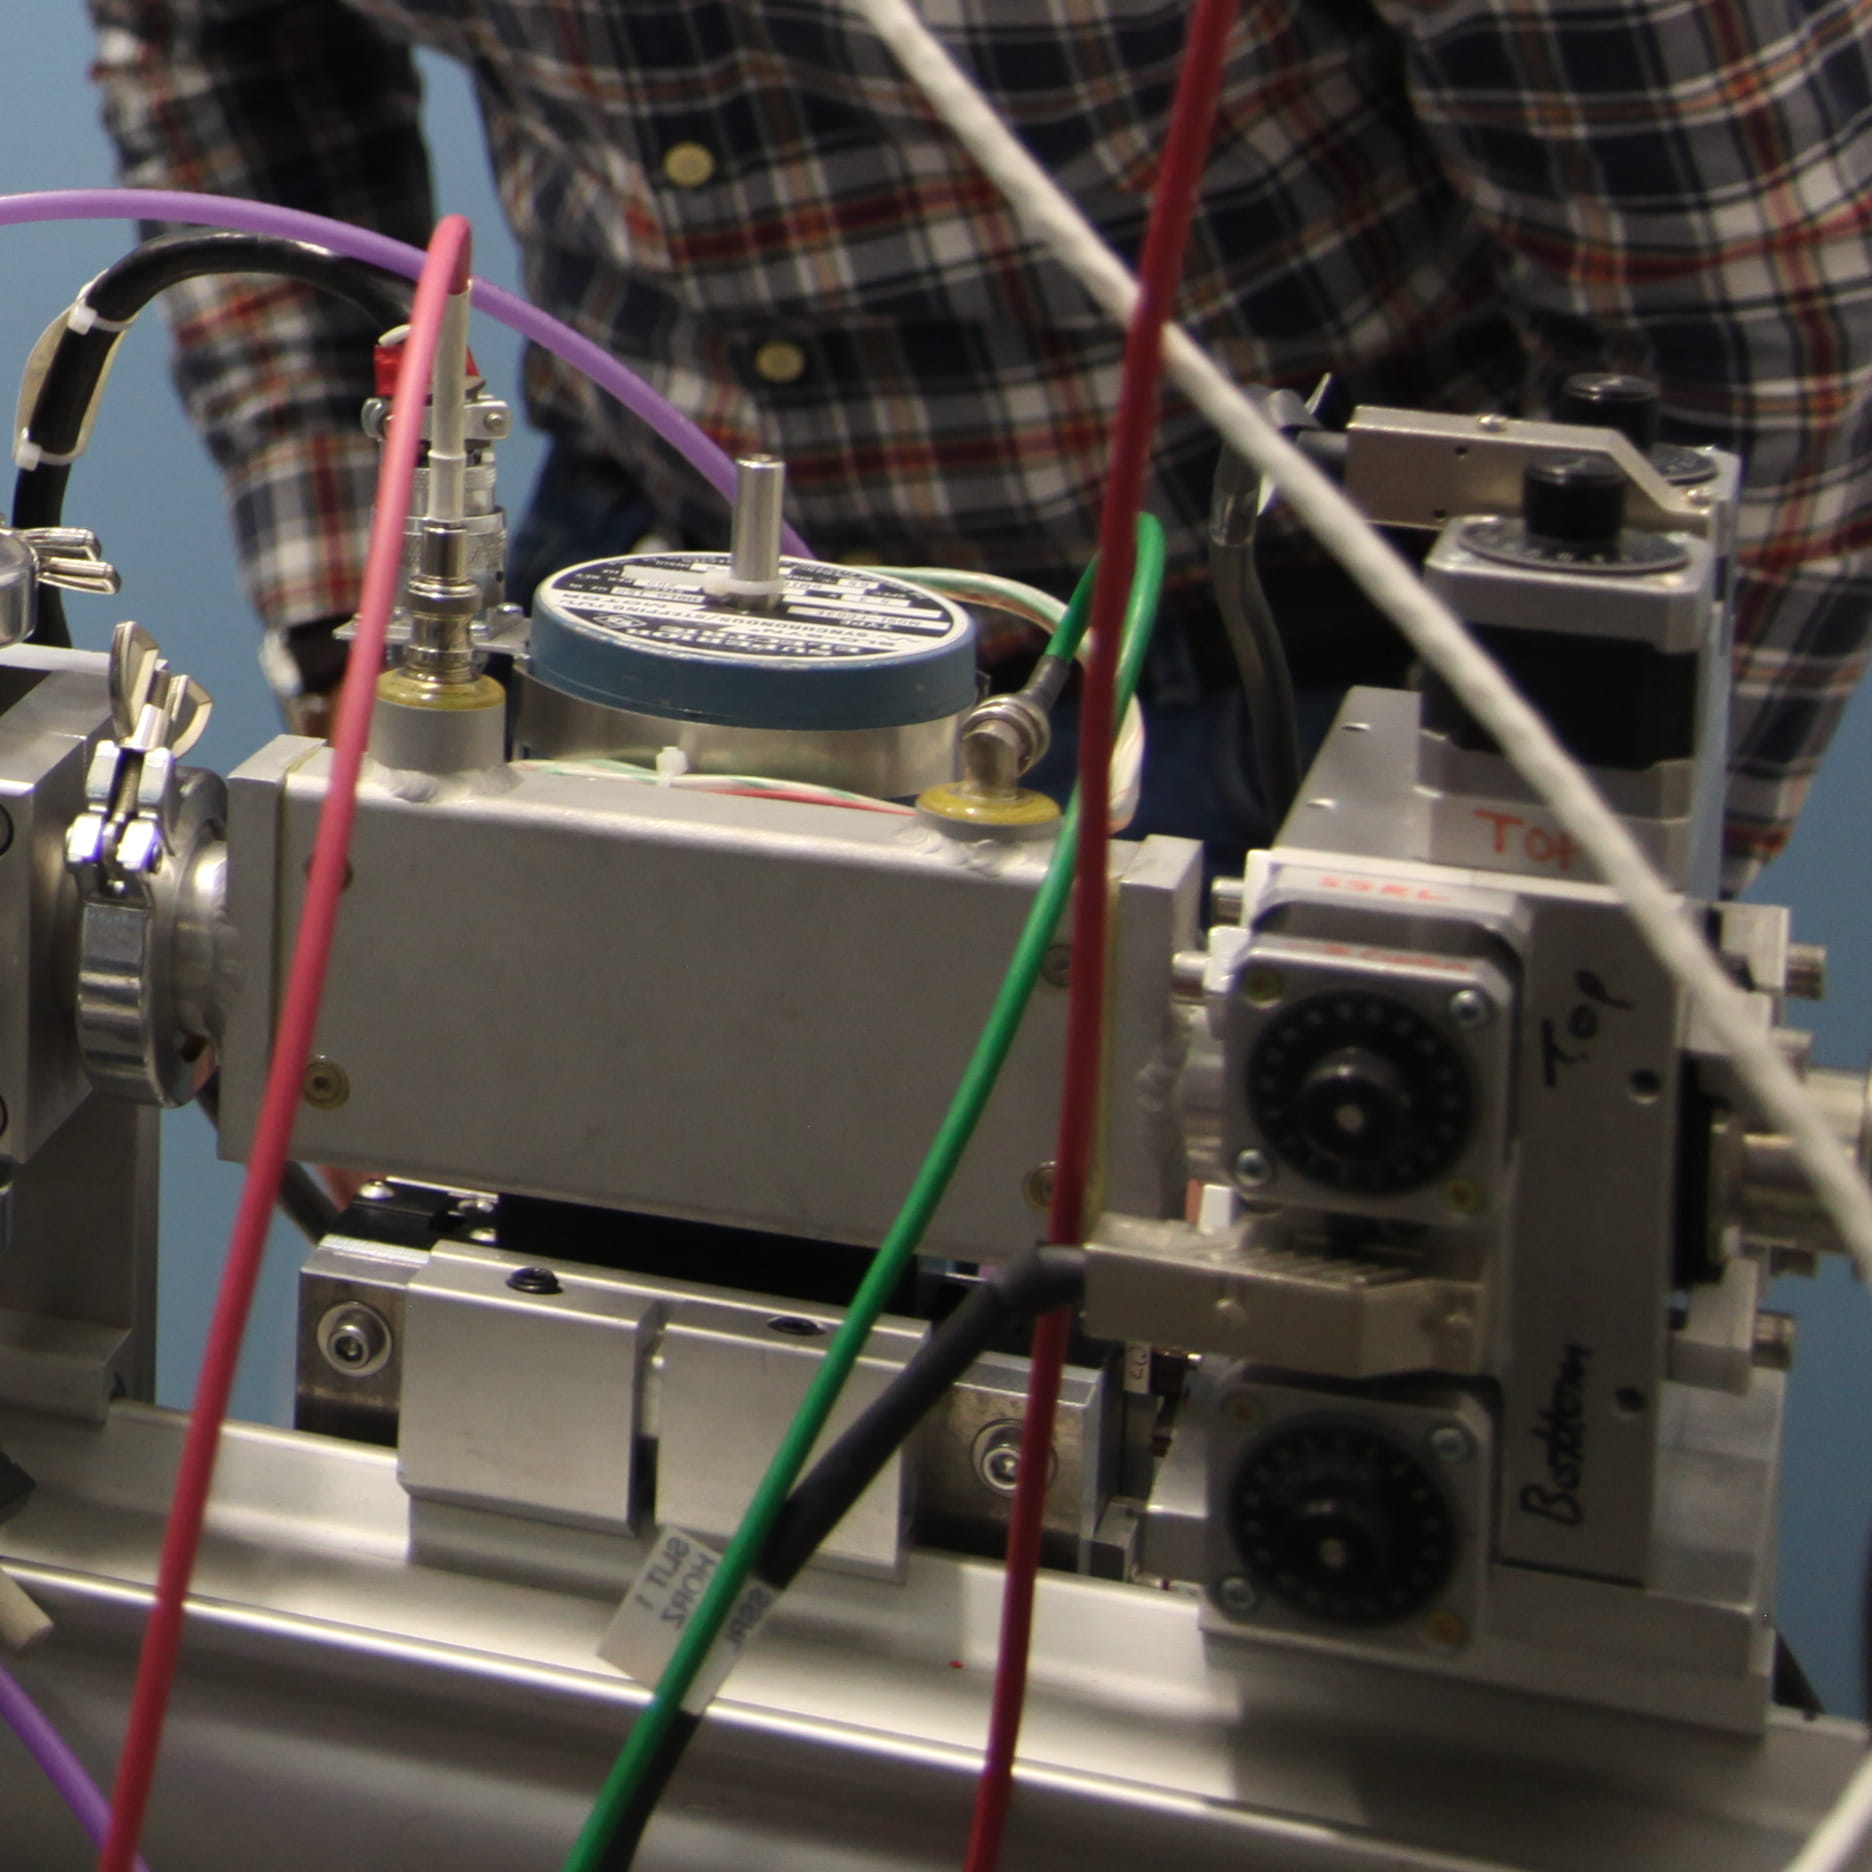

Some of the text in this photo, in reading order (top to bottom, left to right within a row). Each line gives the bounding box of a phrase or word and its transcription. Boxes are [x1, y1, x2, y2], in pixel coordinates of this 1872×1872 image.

[563, 593, 668, 609] MOTOR
[624, 628, 834, 657] SUPERIOR
[657, 625, 861, 654] ELECTRIC
